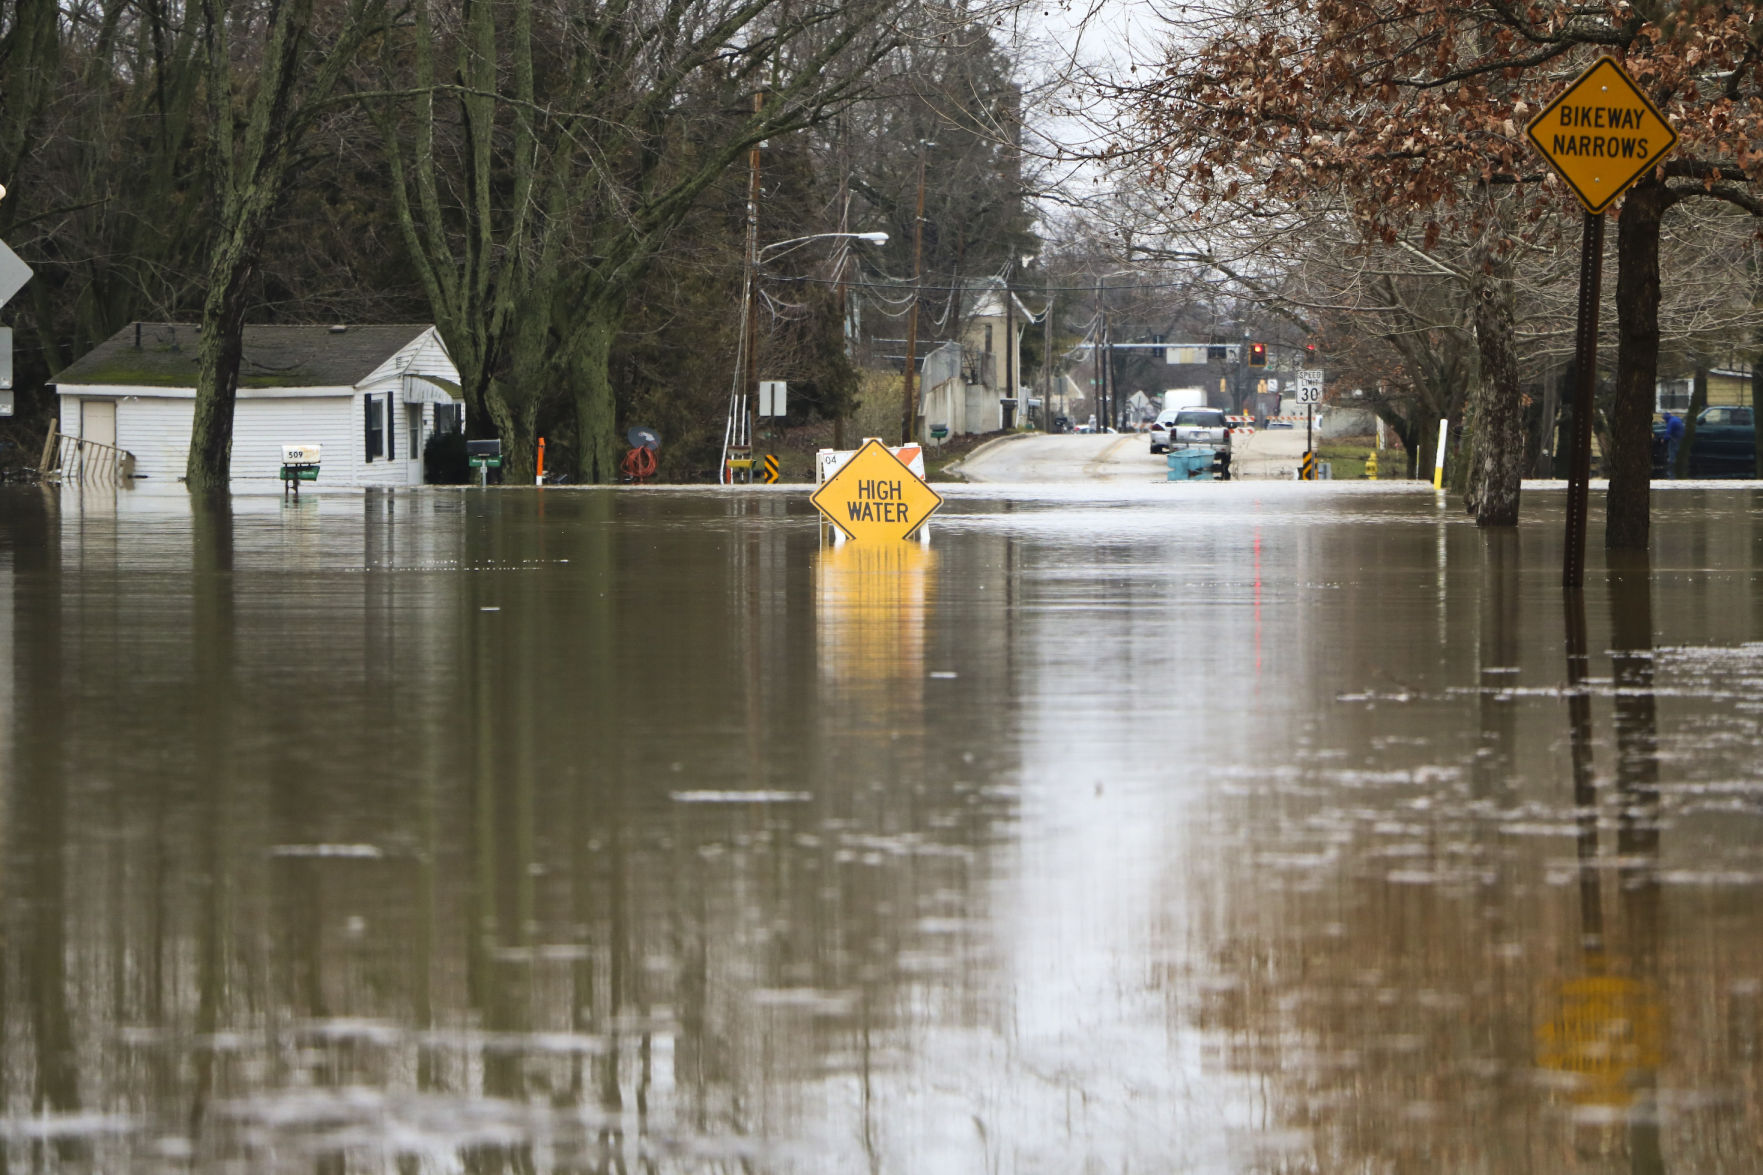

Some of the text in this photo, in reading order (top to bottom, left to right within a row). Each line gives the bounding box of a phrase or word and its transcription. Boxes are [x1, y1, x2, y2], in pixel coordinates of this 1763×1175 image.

[1560, 105, 1646, 130] BIKEWAY
[1553, 134, 1649, 159] NARROWS
[1299, 371, 1321, 379] SPEED
[1301, 387, 1319, 401] 30
[288, 451, 303, 459] 509
[825, 455, 837, 465] 04
[858, 479, 902, 500] HIGH
[847, 501, 909, 523] WATER
